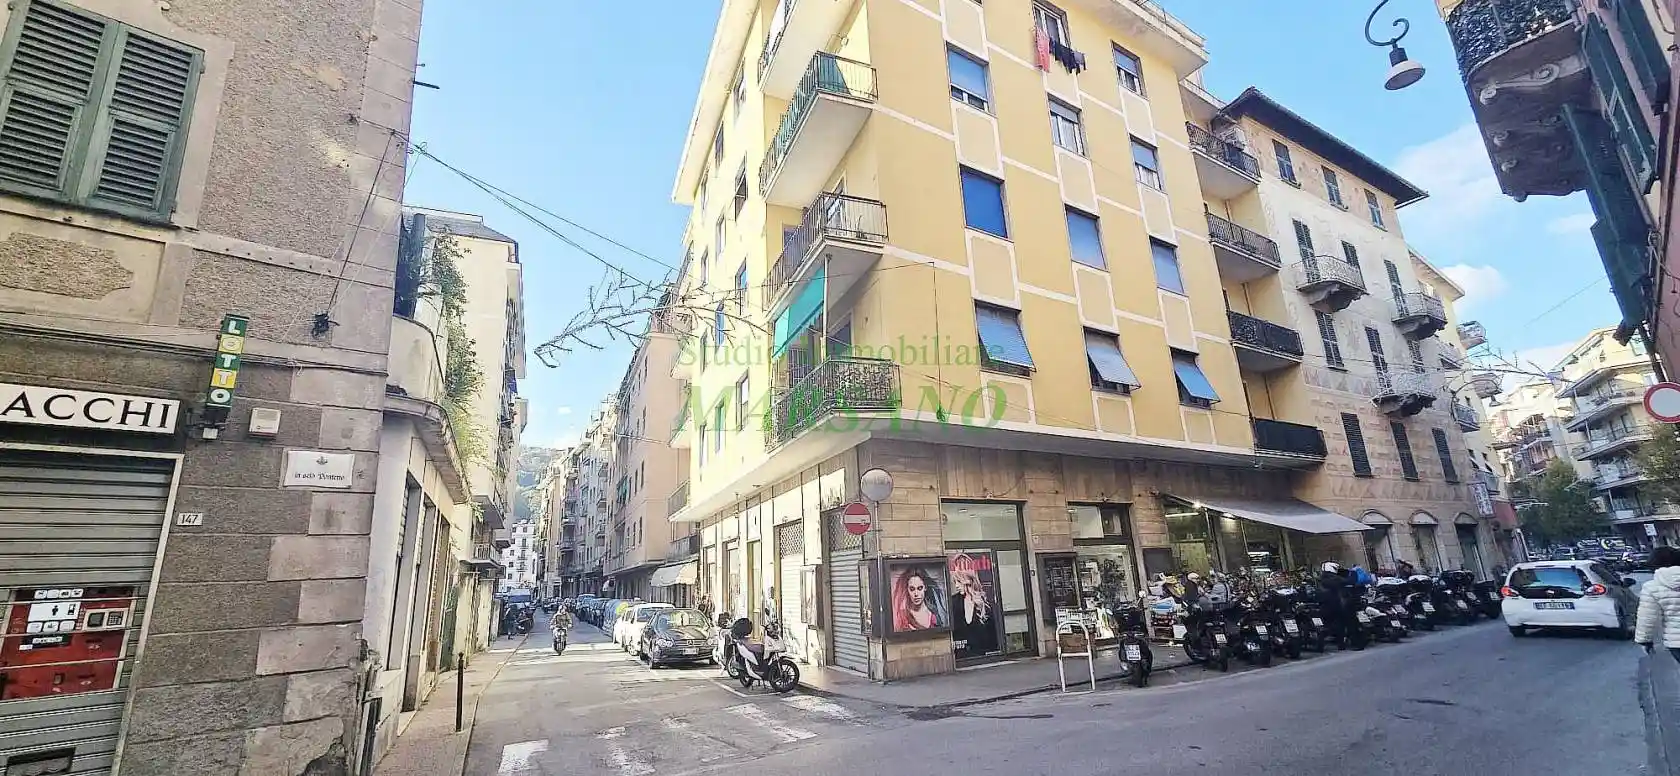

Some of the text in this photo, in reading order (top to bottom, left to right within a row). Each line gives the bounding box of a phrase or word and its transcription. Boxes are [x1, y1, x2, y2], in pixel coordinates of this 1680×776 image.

[210, 320, 243, 403] LOTTO
[0, 391, 172, 428] ACCHI
[181, 514, 199, 524] 147
